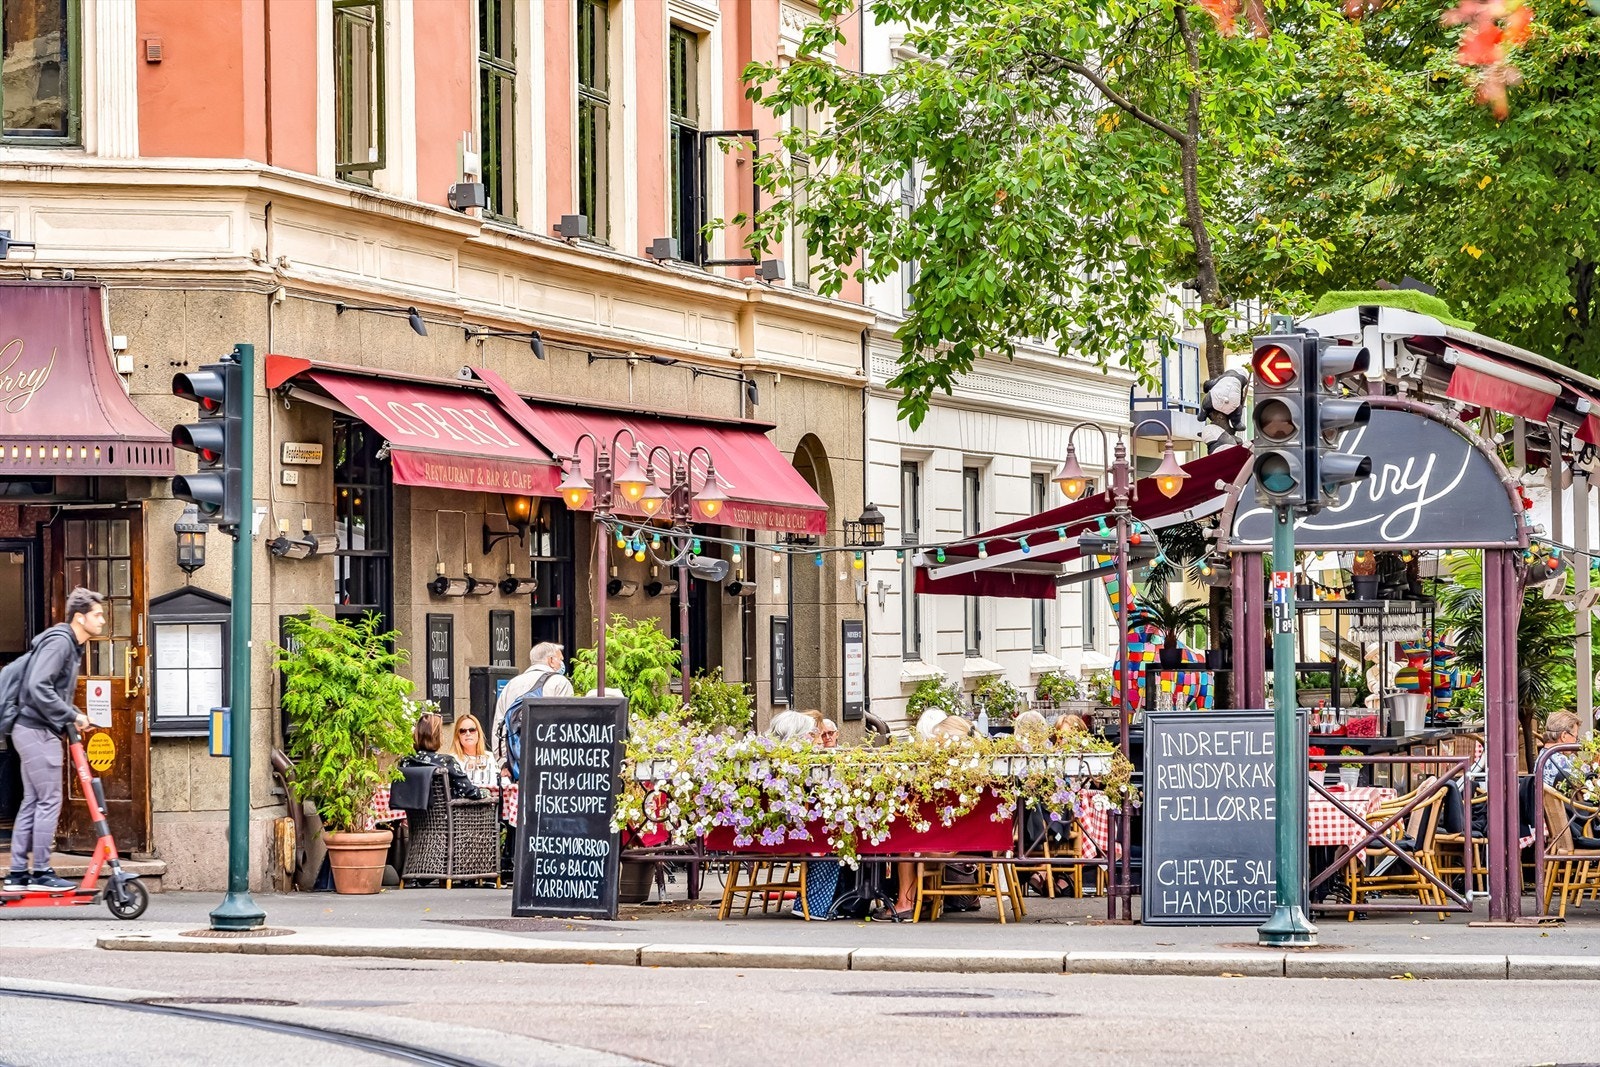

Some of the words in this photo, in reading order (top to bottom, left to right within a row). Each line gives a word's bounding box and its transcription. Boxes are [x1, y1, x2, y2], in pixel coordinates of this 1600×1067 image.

[355, 394, 521, 448] LORRY
[424, 462, 475, 485] RESTAURANT
[477, 467, 484, 485] &
[486, 469, 501, 487] BAR
[503, 470, 511, 489] &
[733, 508, 768, 526] RESTAURANT
[775, 515, 786, 528] BAR
[1274, 606, 1280, 617] 3
[1160, 730, 1275, 757] INDREFILE
[535, 747, 610, 768] HAMBURGER
[540, 771, 568, 791] FISH
[576, 773, 611, 792] CHIPS
[1157, 762, 1276, 790] REINSDYRKAK
[1158, 796, 1276, 821] FJELLØRRE
[535, 858, 558, 876] EGG
[567, 857, 604, 878] BACON
[1157, 859, 1238, 886] CHEVRE
[535, 878, 599, 900] KARBONADE
